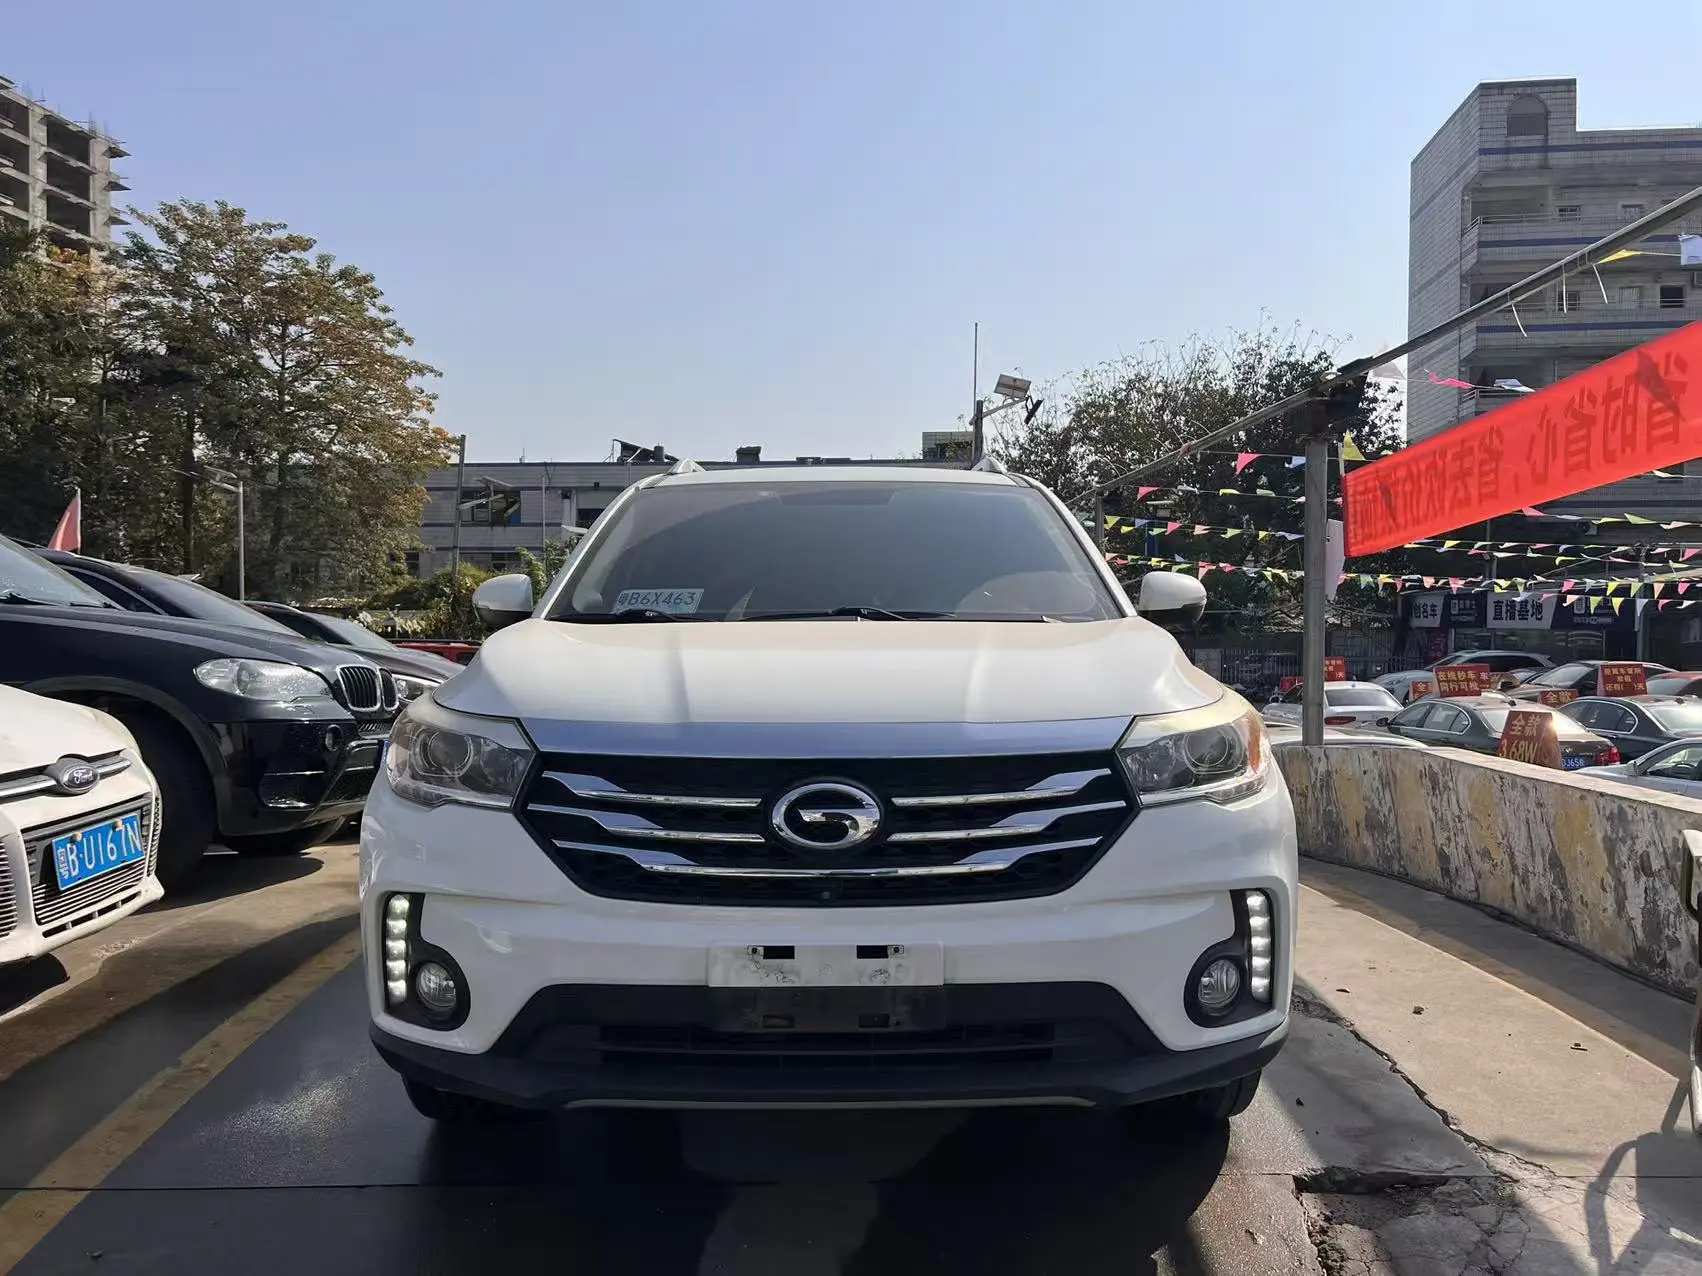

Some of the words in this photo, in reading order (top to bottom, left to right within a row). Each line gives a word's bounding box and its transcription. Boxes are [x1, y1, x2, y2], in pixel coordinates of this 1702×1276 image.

[1493, 599, 1543, 621] 直播基地
[1510, 712, 1541, 737] 全款
[73, 768, 94, 784] Ford
